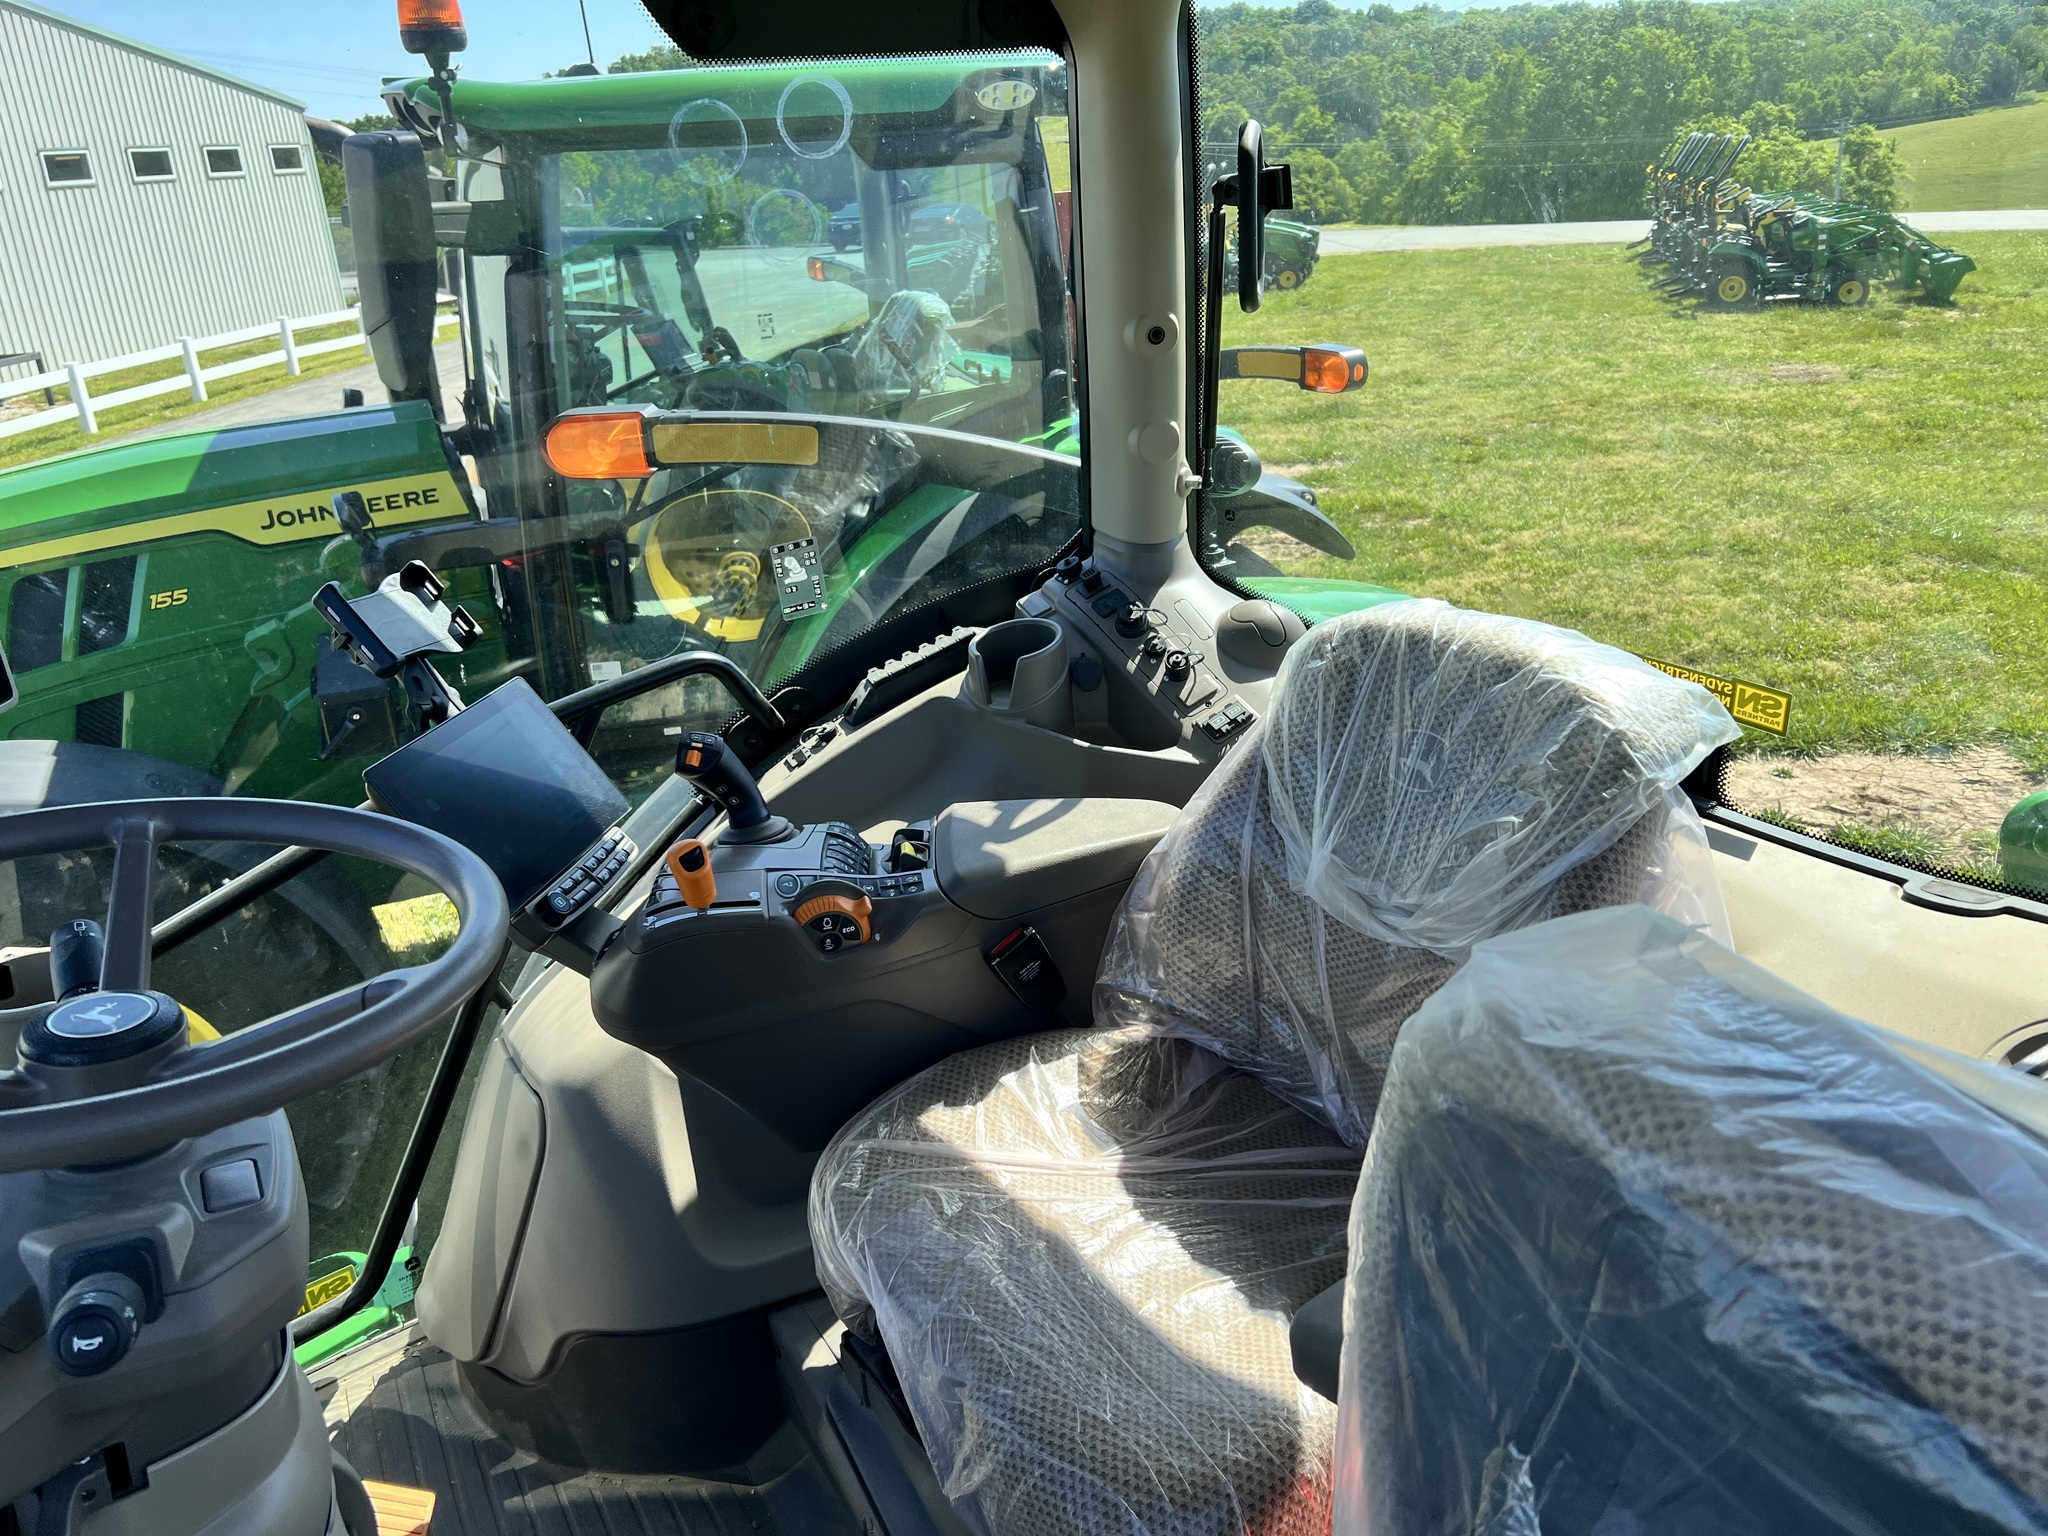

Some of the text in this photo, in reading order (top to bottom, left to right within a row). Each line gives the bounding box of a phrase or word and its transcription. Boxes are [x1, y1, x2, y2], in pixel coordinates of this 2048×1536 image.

[366, 488, 440, 514] EERE
[149, 587, 189, 610] 155
[842, 925, 856, 934] ECO
